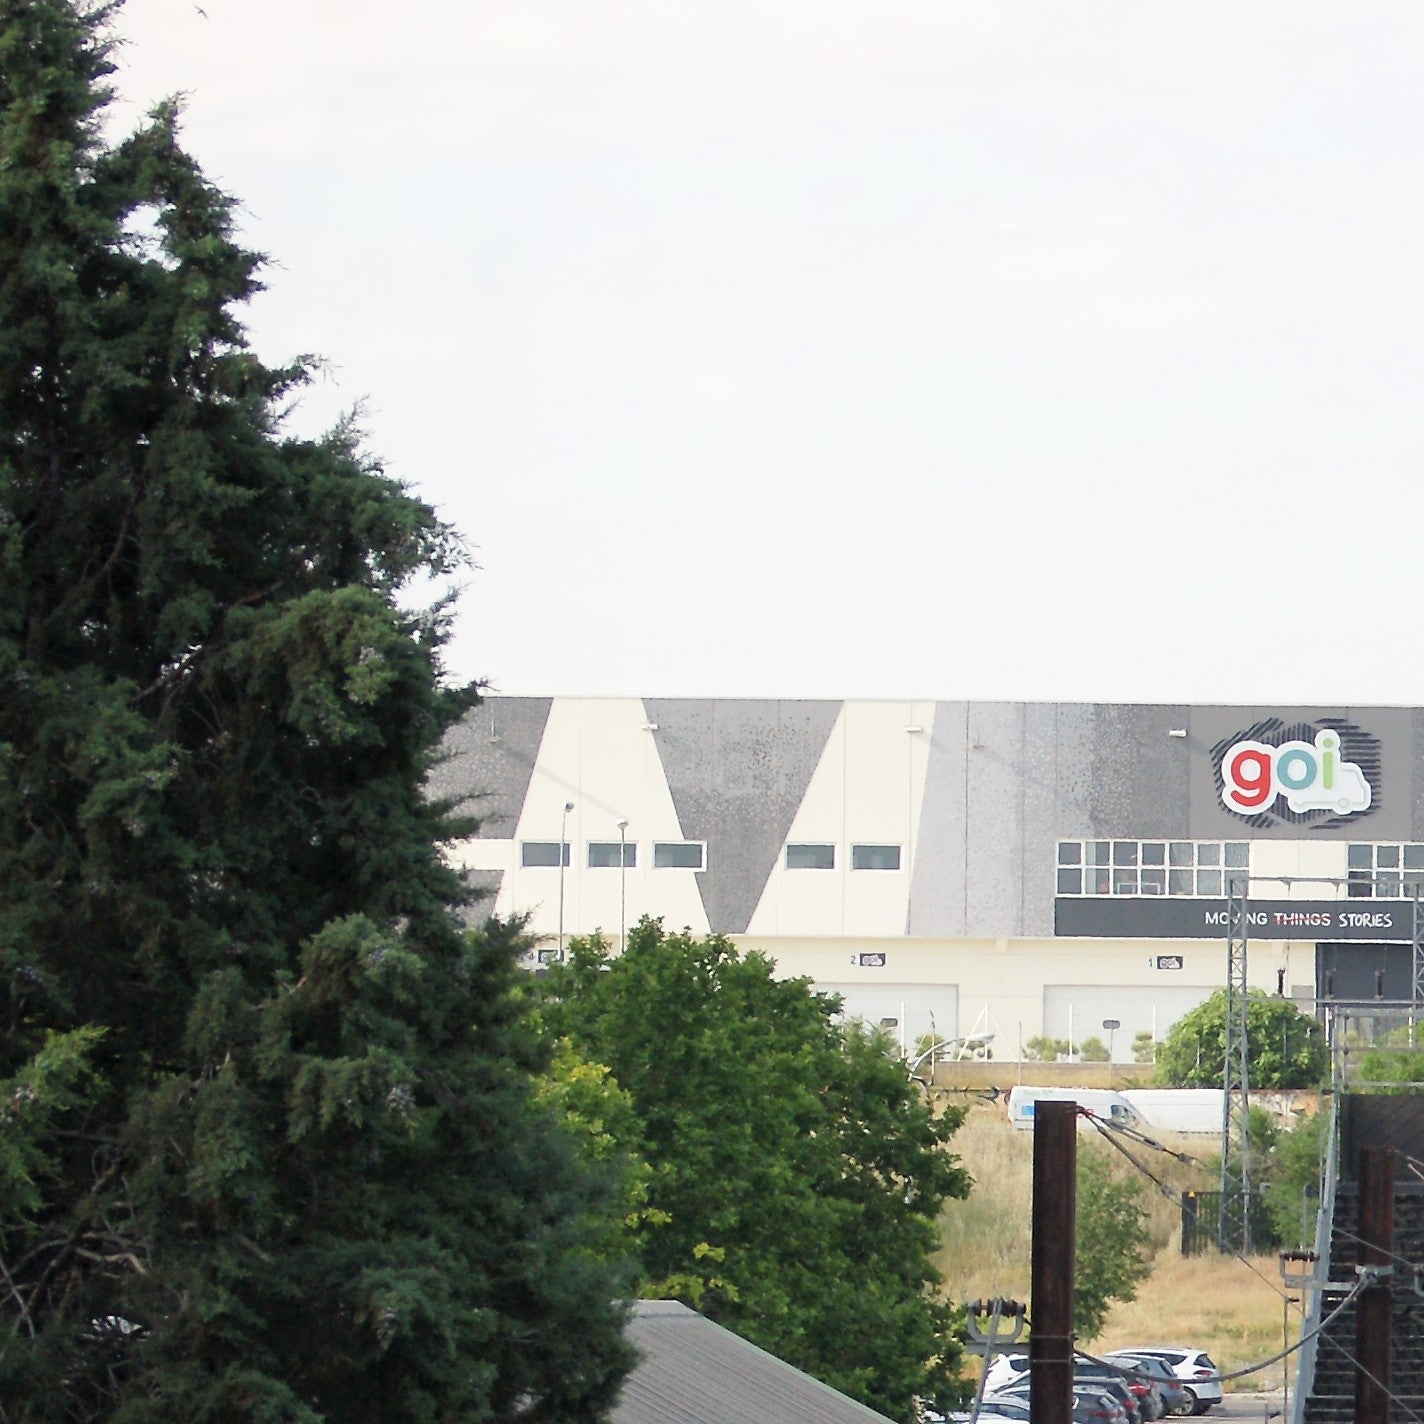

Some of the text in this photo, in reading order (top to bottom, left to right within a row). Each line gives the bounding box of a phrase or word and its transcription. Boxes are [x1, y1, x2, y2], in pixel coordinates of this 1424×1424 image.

[1230, 738, 1334, 807] goi
[1204, 911, 1393, 928] MOVNG THINGS STORIES
